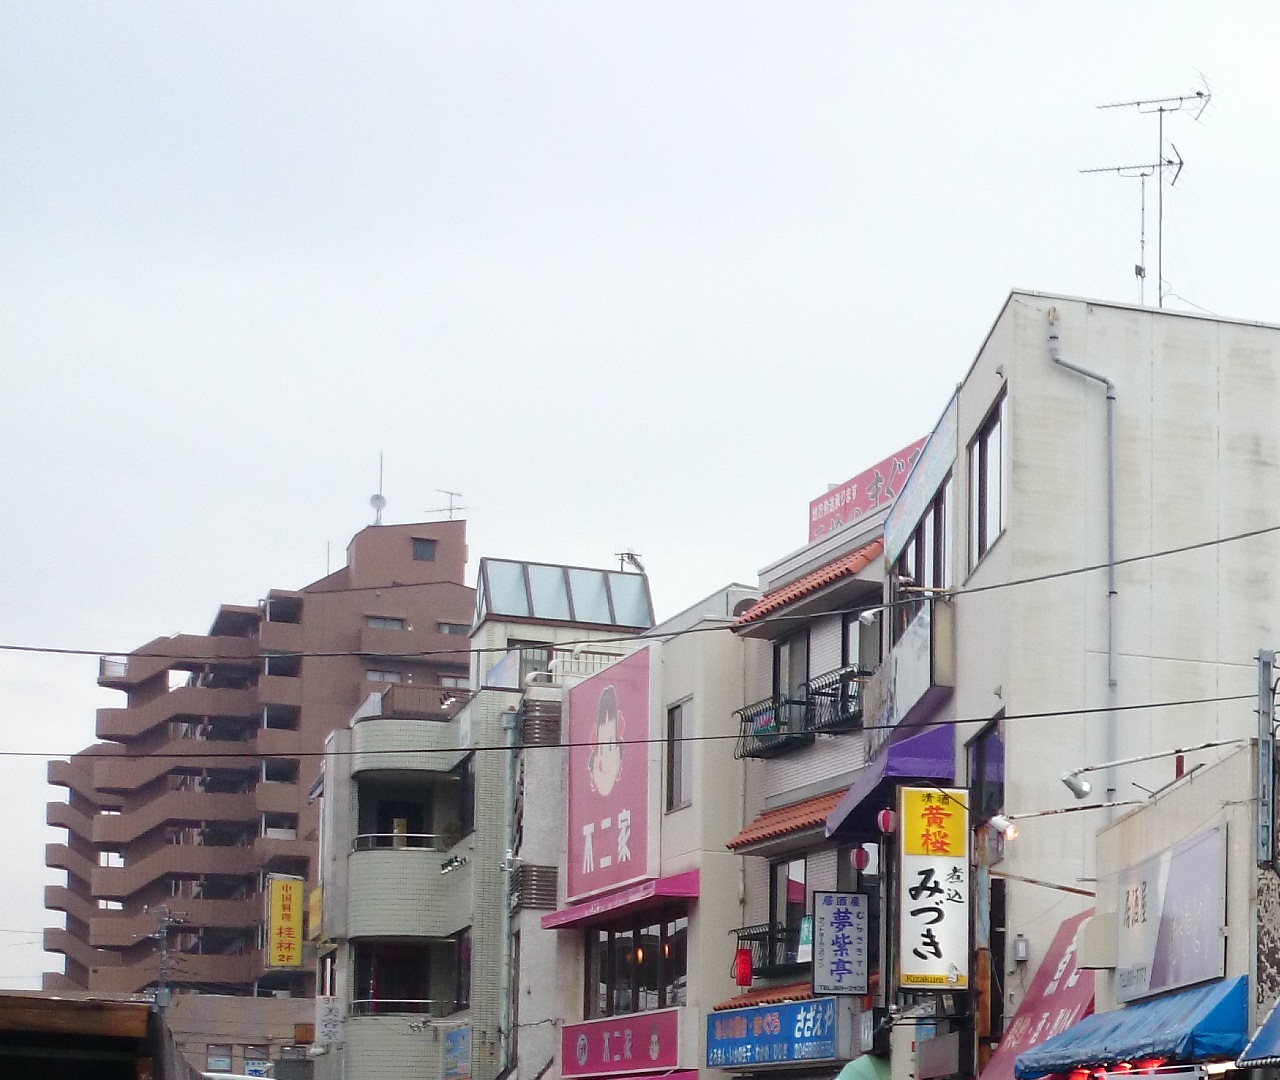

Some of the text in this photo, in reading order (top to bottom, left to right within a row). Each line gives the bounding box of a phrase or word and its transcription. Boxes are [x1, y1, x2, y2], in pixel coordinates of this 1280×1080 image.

[921, 793, 950, 805] 清酒
[583, 809, 631, 875] 不二家
[921, 805, 951, 854] 黄桜
[281, 883, 293, 922] 中国料理
[823, 895, 861, 907] 居酒屋
[946, 866, 965, 904] 煮込
[909, 868, 945, 961] みづき
[276, 926, 296, 952] 桂林
[831, 907, 854, 983] 夢紫亭
[278, 954, 293, 963] 2F
[906, 974, 944, 985] Kizakura
[794, 1005, 834, 1038] さざえや
[603, 1027, 633, 1062] 不二家
